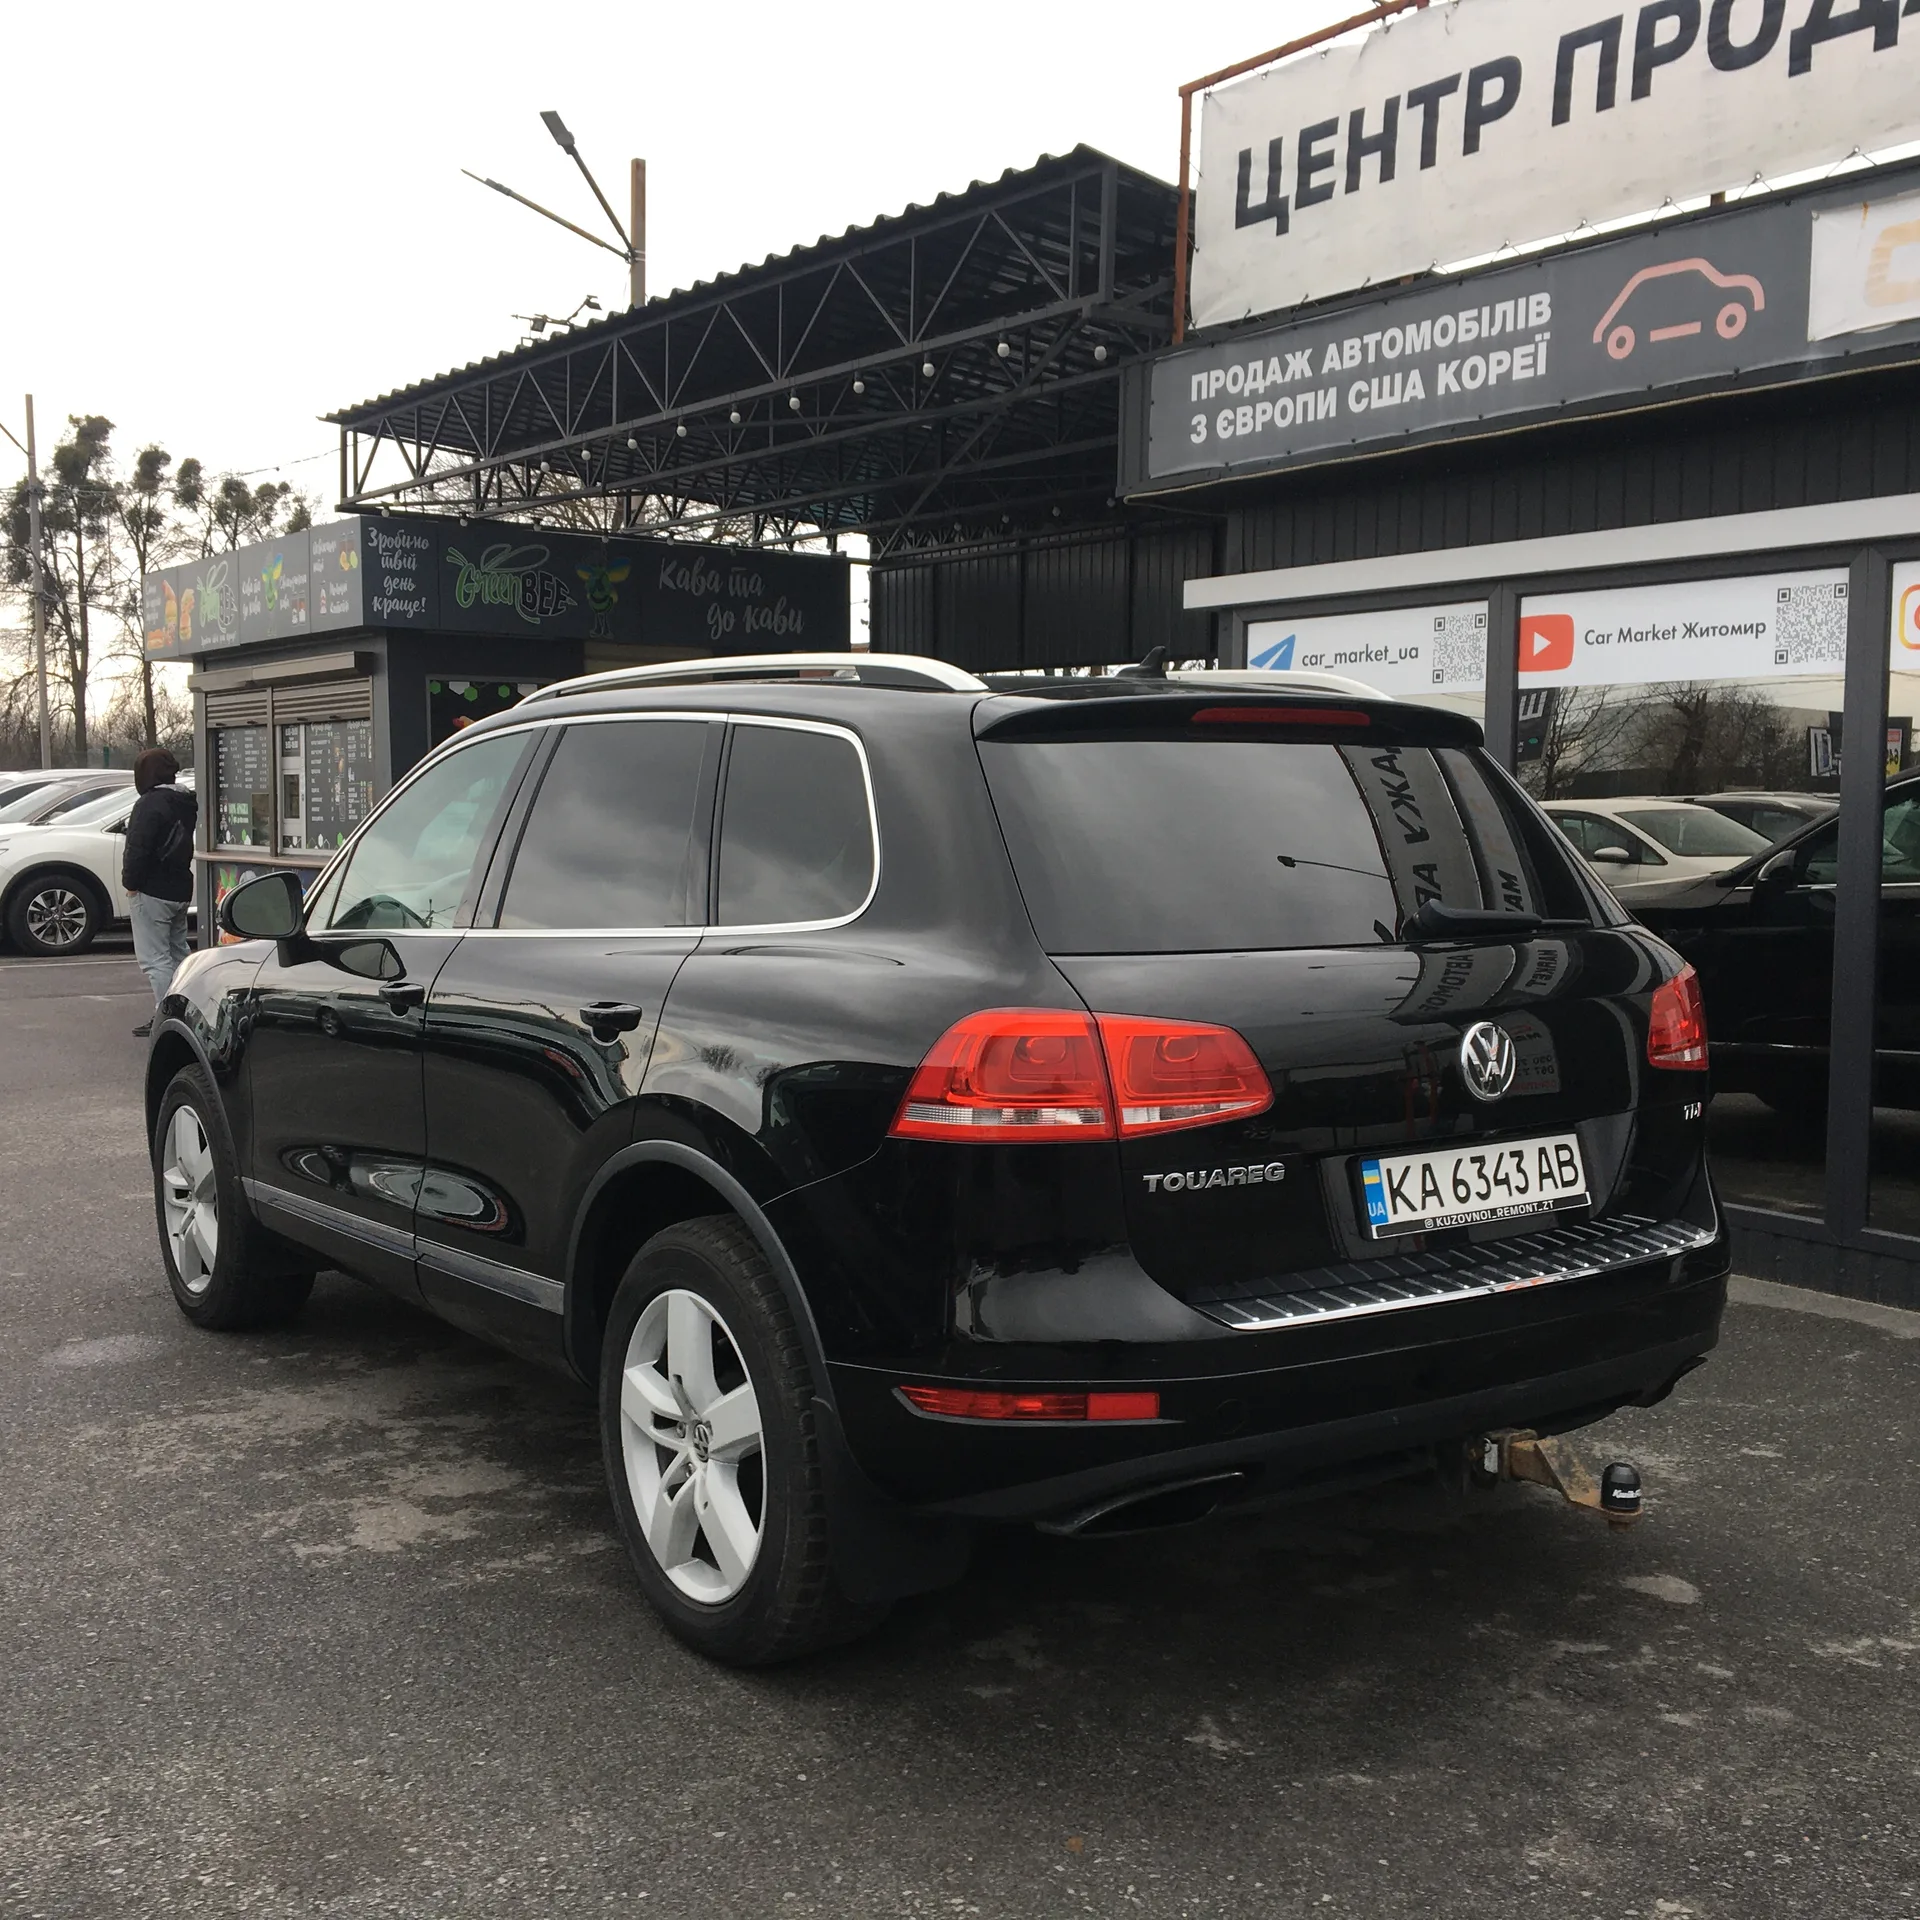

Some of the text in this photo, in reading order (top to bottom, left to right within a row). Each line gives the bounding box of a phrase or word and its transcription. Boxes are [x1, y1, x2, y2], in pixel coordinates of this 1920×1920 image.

[1234, 0, 1920, 236] ЦЕНТР ПРОД
[1190, 291, 1552, 402] ПРОДАЖ АВТОМОБІЛІВ
[1189, 332, 1551, 444] З ЄВРОПИ США КОРЕЇ
[368, 526, 430, 555] Зробимо
[381, 549, 418, 571] твій
[383, 575, 417, 596] день
[1584, 621, 1767, 646] Car Market Житомир
[1301, 643, 1419, 669] car_market_ua
[1142, 1161, 1286, 1193] TOUAREG
[1385, 1143, 1579, 1216] KA 6343 AB
[1368, 1202, 1386, 1217] UA
